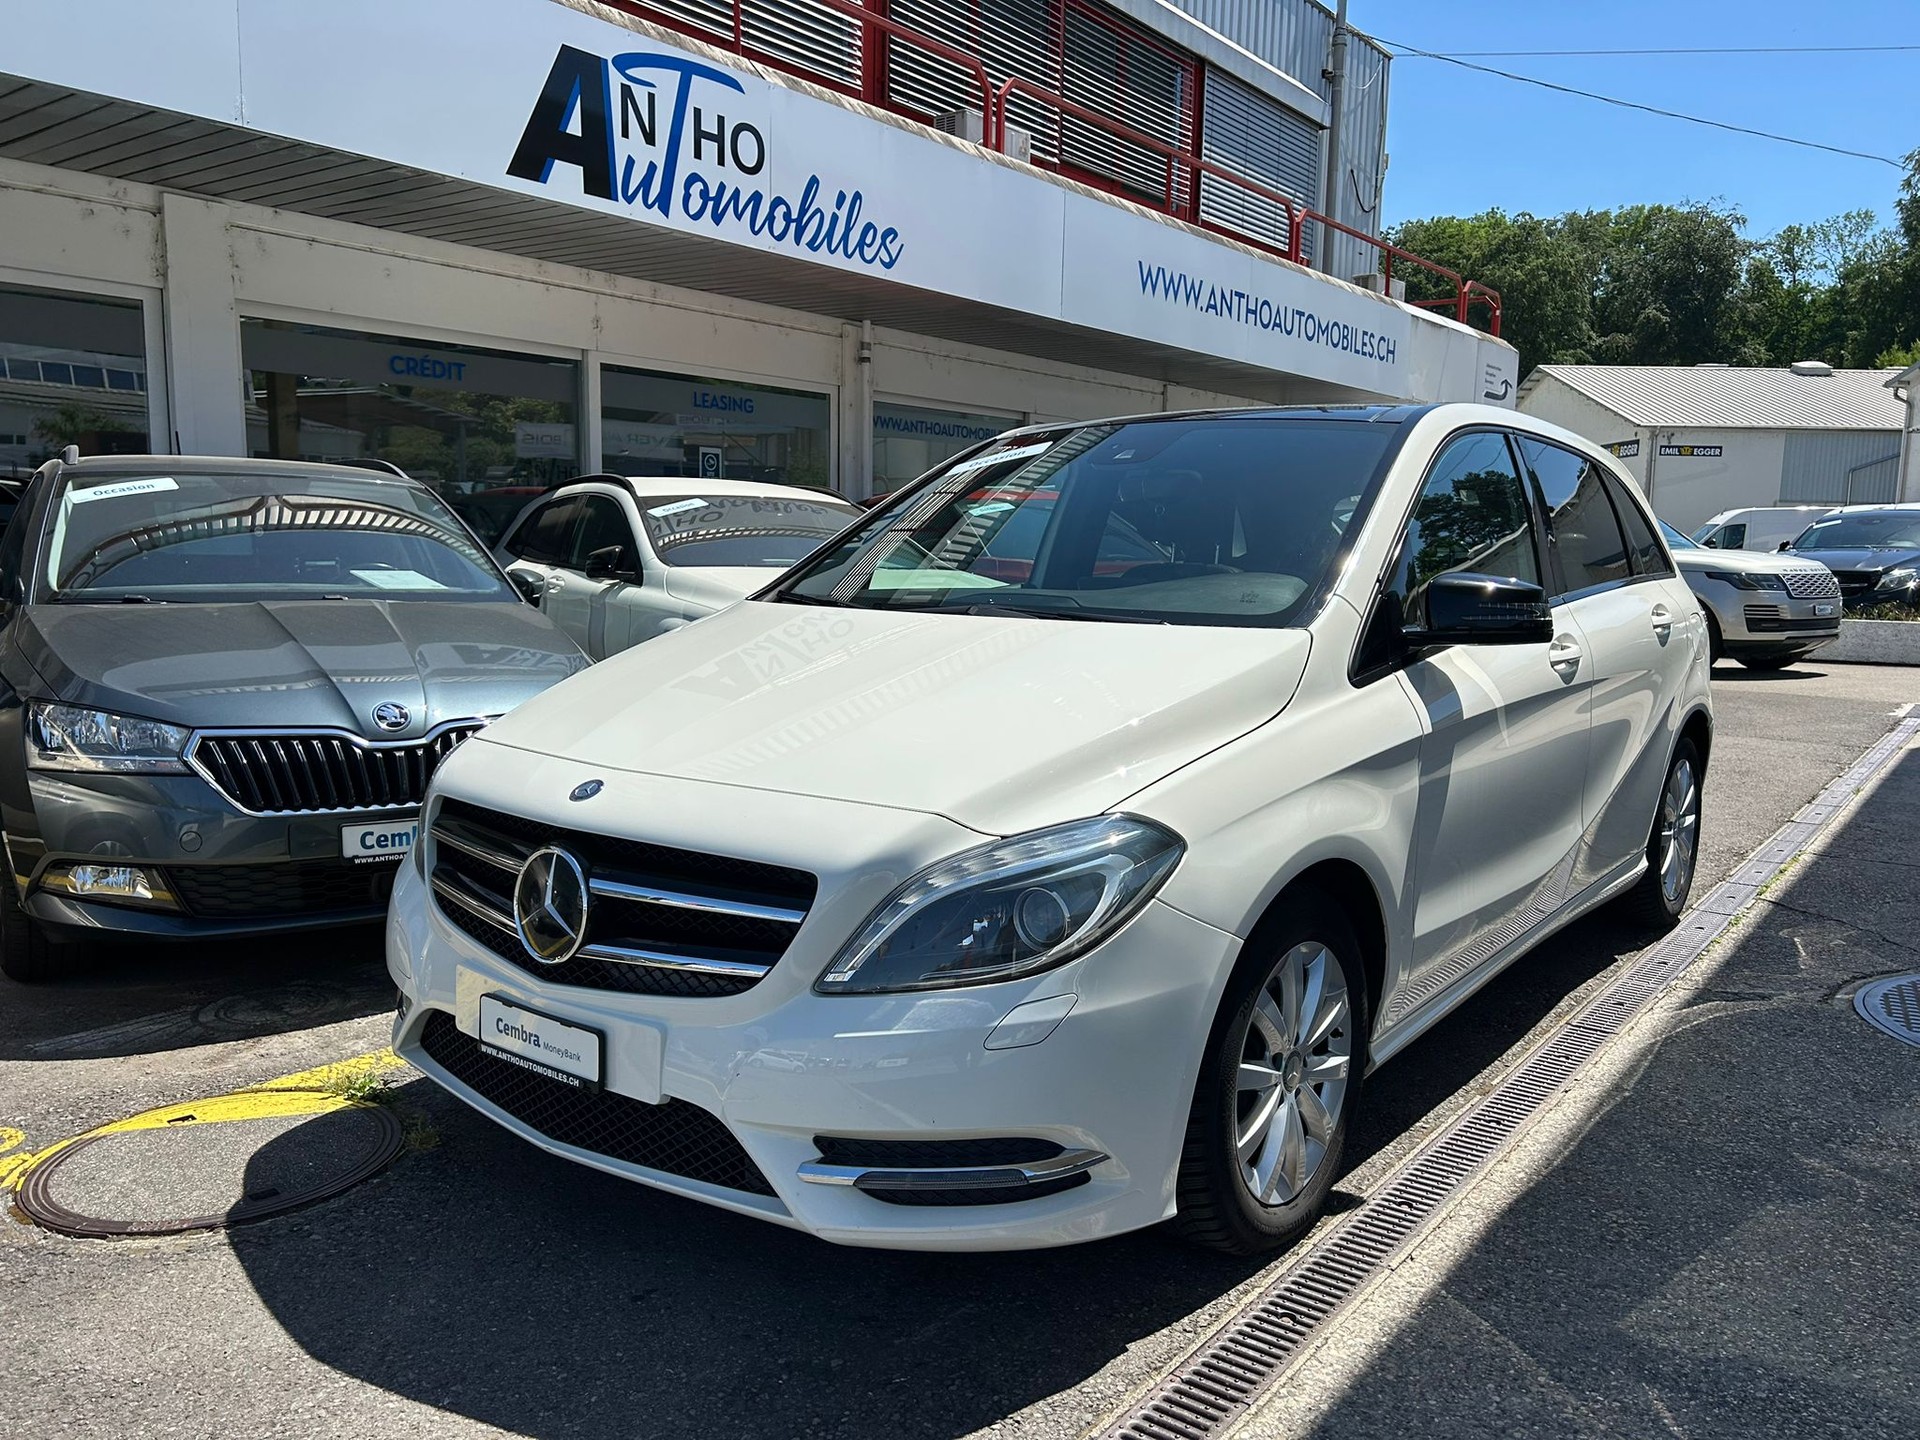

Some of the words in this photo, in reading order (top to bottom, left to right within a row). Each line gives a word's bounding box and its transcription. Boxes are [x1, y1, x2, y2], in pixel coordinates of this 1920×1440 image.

[1138, 260, 1396, 364] WWW.ANTHOAUTOMOBILES.CH
[390, 355, 466, 381] CRÉDIT
[693, 391, 755, 414] LEASING
[968, 450, 1026, 468] Occasion
[1661, 447, 1680, 455] EMIL
[1693, 448, 1721, 456] EGGER
[93, 483, 155, 496] Occasion
[354, 854, 408, 864] WWW.ANTHOA
[496, 1017, 541, 1048] Cembra
[543, 1041, 582, 1062] MoneyBank
[480, 1044, 580, 1087] WWW.ANTHOAUTOMOBILES.CH
